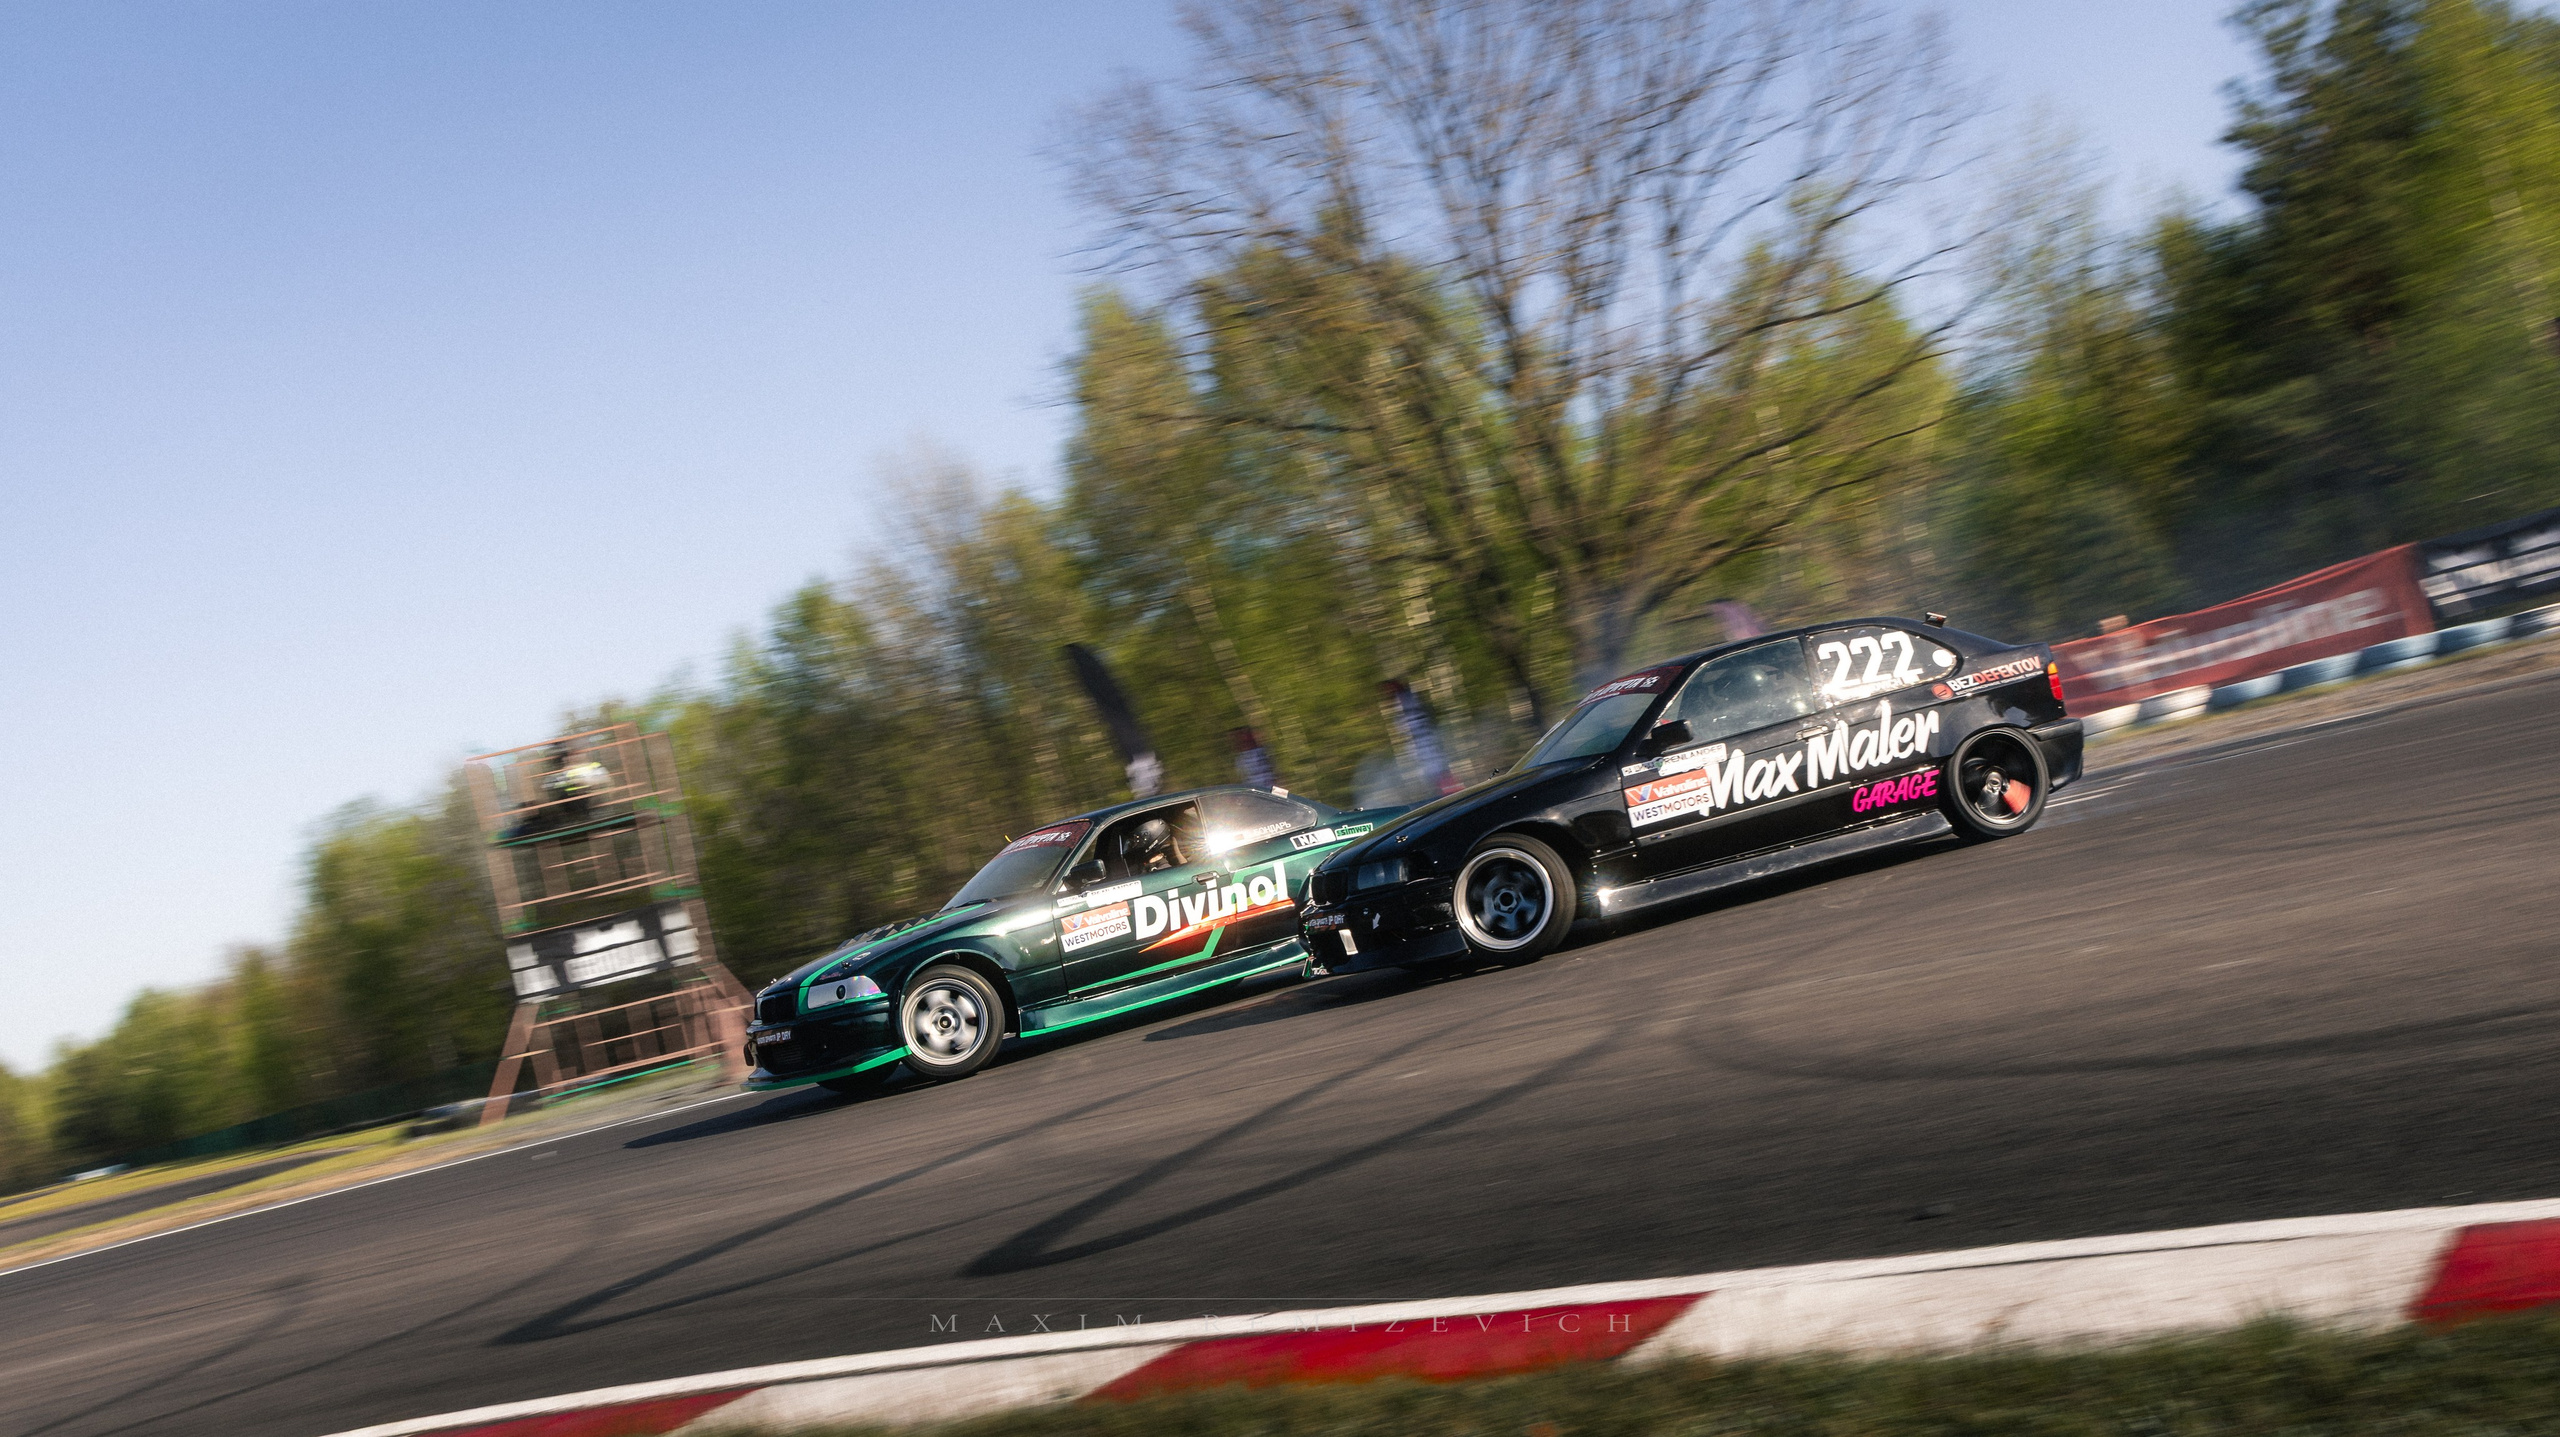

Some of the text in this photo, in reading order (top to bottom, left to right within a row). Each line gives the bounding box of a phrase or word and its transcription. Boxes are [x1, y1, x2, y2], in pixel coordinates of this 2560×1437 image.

[1818, 631, 1924, 686] 222
[1946, 655, 2042, 692] BEZDEFEKTOV
[1806, 700, 1940, 789] Maler
[1653, 777, 1709, 798] Valvoline
[1852, 769, 1940, 813] GARAGE
[1633, 793, 1710, 821] WESTMOTORS
[1084, 907, 1129, 926] Valvoline
[1134, 861, 1289, 940] Divinol
[1065, 921, 1128, 947] WESTMOTORS
